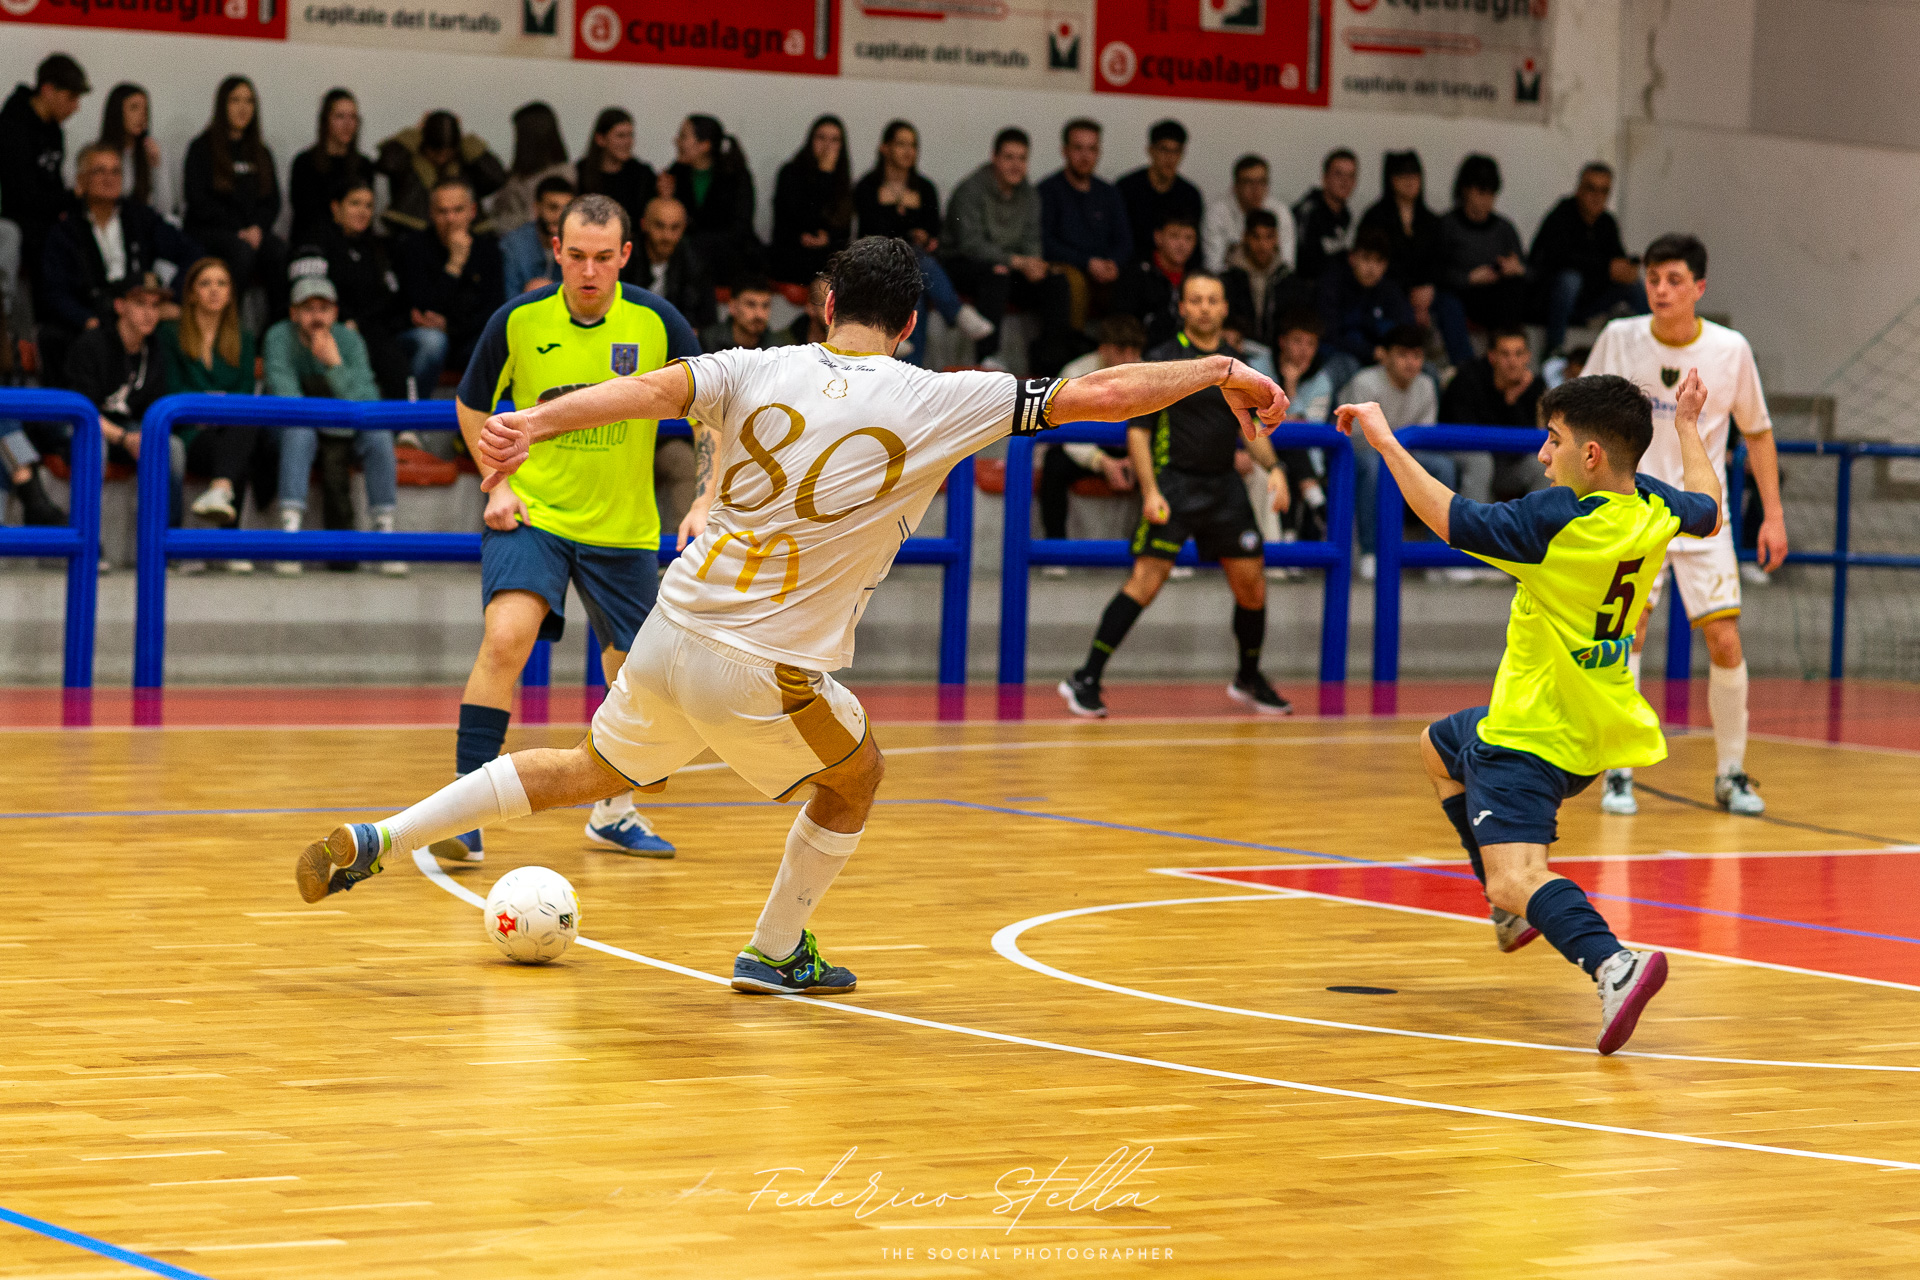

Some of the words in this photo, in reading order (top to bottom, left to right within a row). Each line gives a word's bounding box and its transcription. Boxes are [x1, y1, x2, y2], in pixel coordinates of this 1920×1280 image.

[304, 6, 388, 26] capitale
[392, 9, 425, 29] del
[429, 12, 500, 34] tartufo
[719, 403, 907, 524] 80
[1593, 556, 1646, 642] 5
